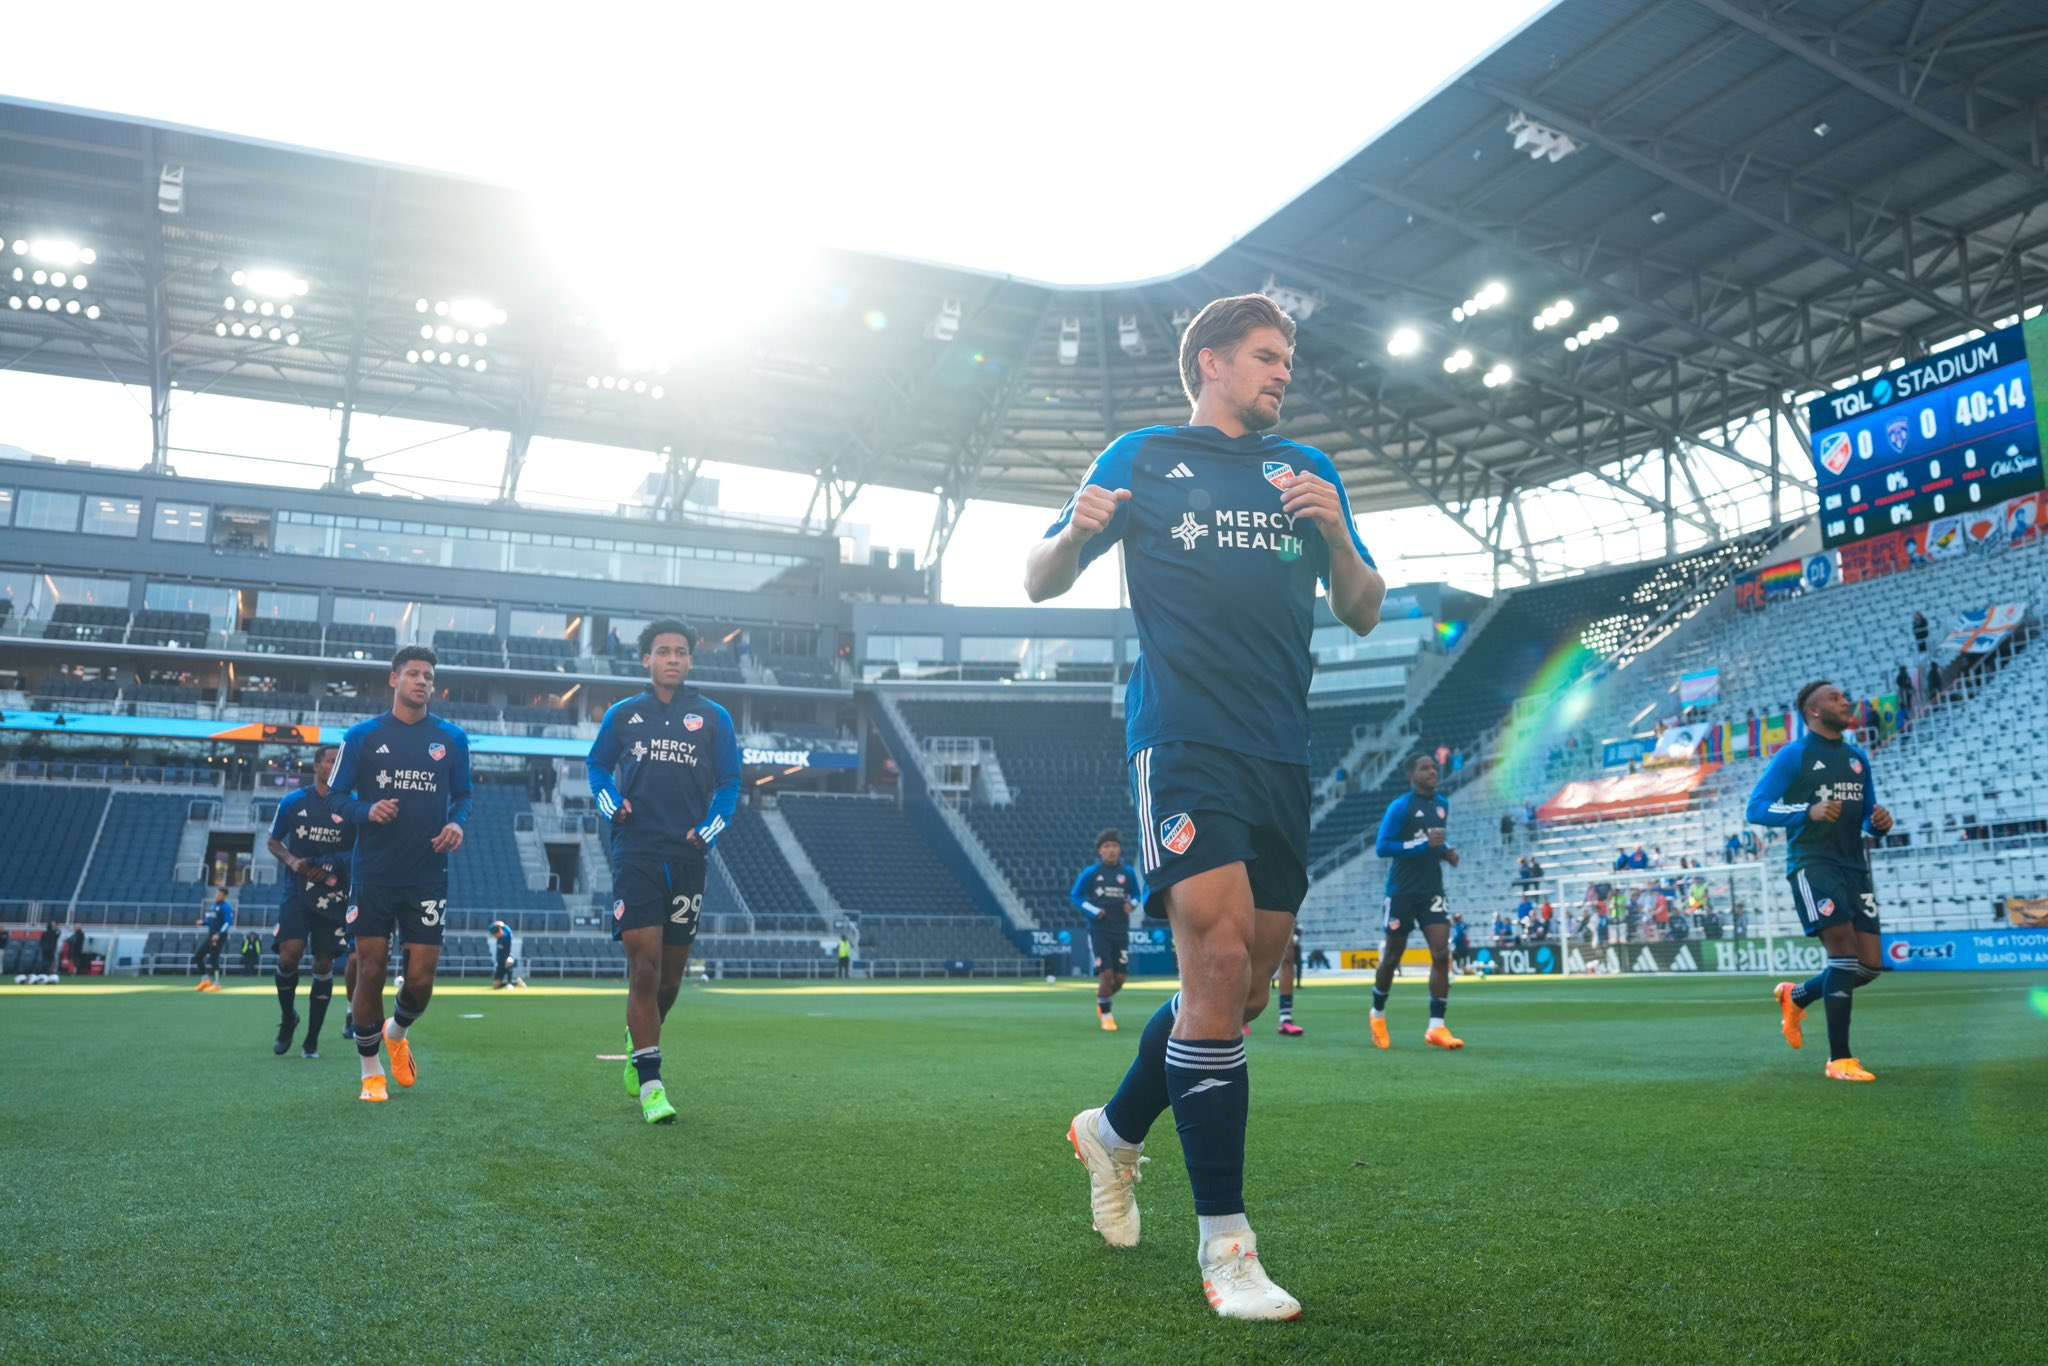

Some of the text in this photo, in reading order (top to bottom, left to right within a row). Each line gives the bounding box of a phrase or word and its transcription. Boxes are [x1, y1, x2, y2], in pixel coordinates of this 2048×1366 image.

[1831, 341, 1999, 420] TQL STADIUM
[1857, 377, 2027, 460] 0 0 40:14
[1850, 484, 1861, 503] 0
[1929, 459, 1941, 480] 0
[1964, 448, 1977, 469] 0
[1854, 516, 1865, 535] 0
[1934, 493, 1945, 514] 0
[1968, 482, 1981, 503] 0
[1215, 509, 1298, 531] MERCY
[1217, 530, 1303, 556] HEALTH
[651, 738, 696, 753] MERCY
[650, 750, 698, 767] HEALTH
[742, 748, 810, 767] SEATGEEK
[395, 769, 436, 781] MERCY
[394, 780, 437, 793] HEALTH
[310, 826, 341, 836] MERCY
[670, 893, 703, 936] 29
[1031, 931, 1058, 944] TQL
[1127, 931, 1153, 944] TQL
[1973, 936, 1995, 948] THE
[1499, 949, 1537, 973] TQL
[1890, 942, 1955, 962] Crest
[1977, 952, 2018, 965] BRAND
